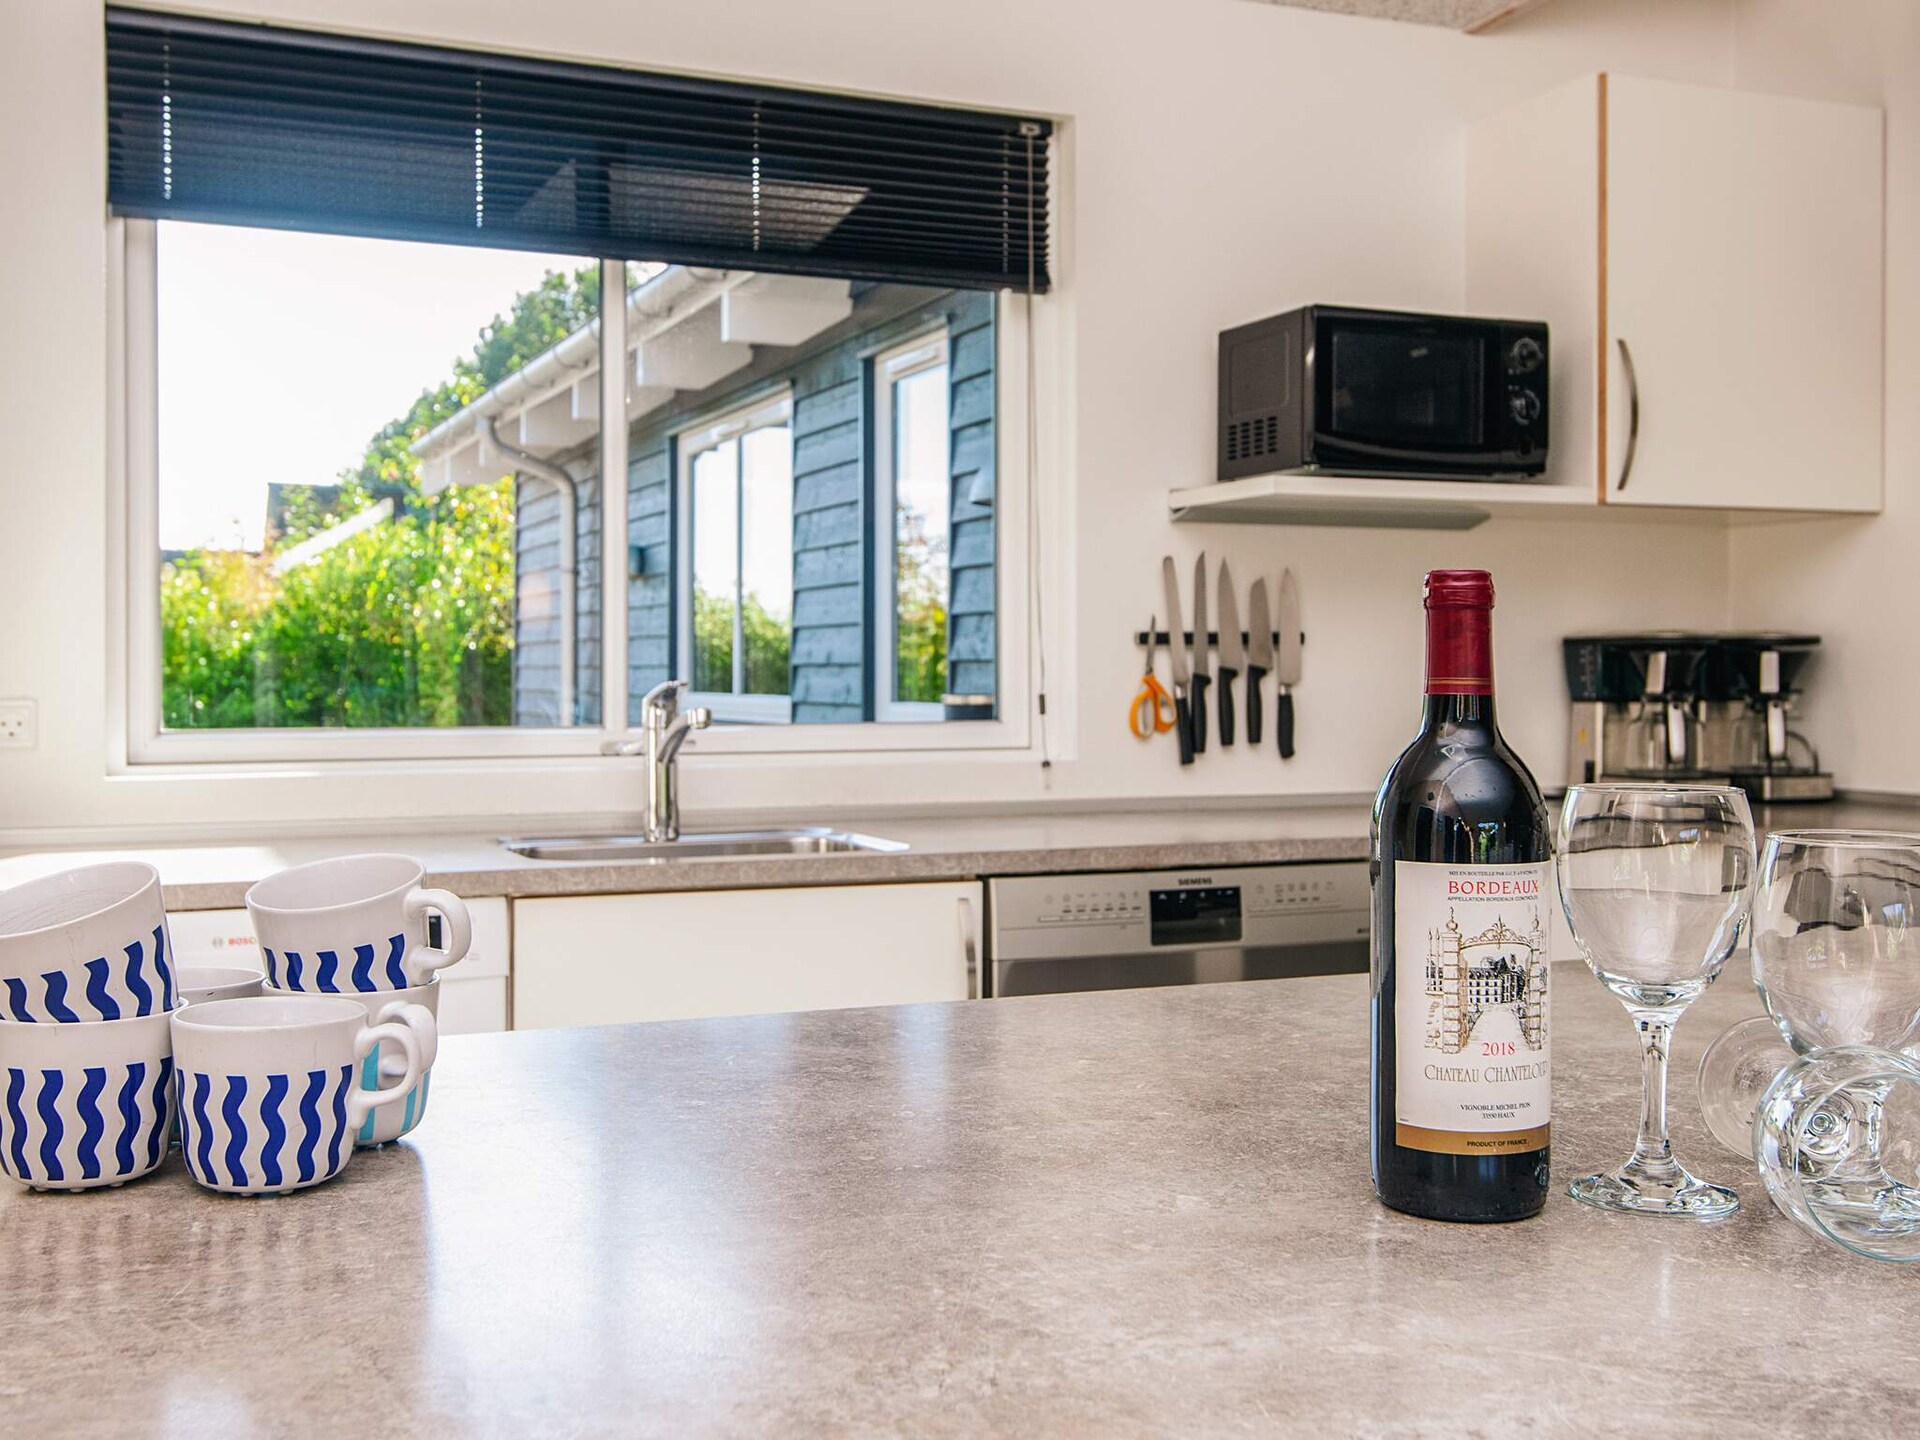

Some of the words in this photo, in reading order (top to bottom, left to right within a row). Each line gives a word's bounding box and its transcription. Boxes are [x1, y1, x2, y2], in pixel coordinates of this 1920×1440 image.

[1178, 877, 1212, 886] SIEMENS
[1449, 880, 1539, 895] BORDEAUX
[228, 937, 258, 946] BOSC
[1482, 1041, 1516, 1056] 2018
[1424, 1064, 1479, 1083] CHATEAU
